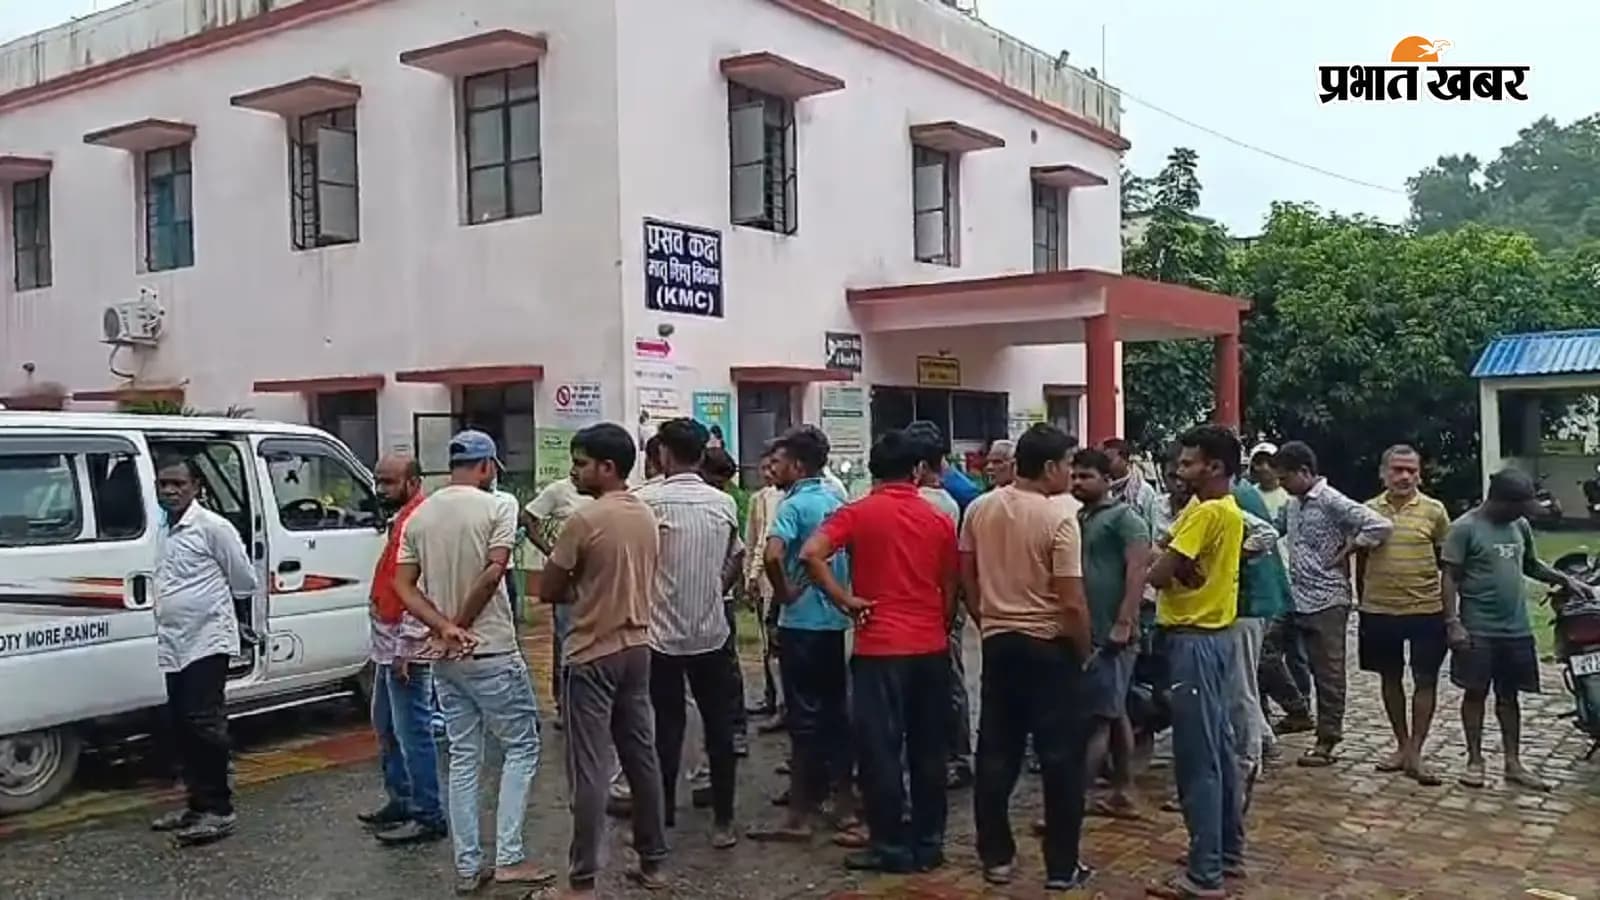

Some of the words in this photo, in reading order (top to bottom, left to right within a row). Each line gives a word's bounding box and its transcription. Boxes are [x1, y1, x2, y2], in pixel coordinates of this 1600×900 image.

[646, 225, 684, 255] प्रसव
[687, 232, 719, 263] कक्ष
[656, 285, 714, 315] (KMC)
